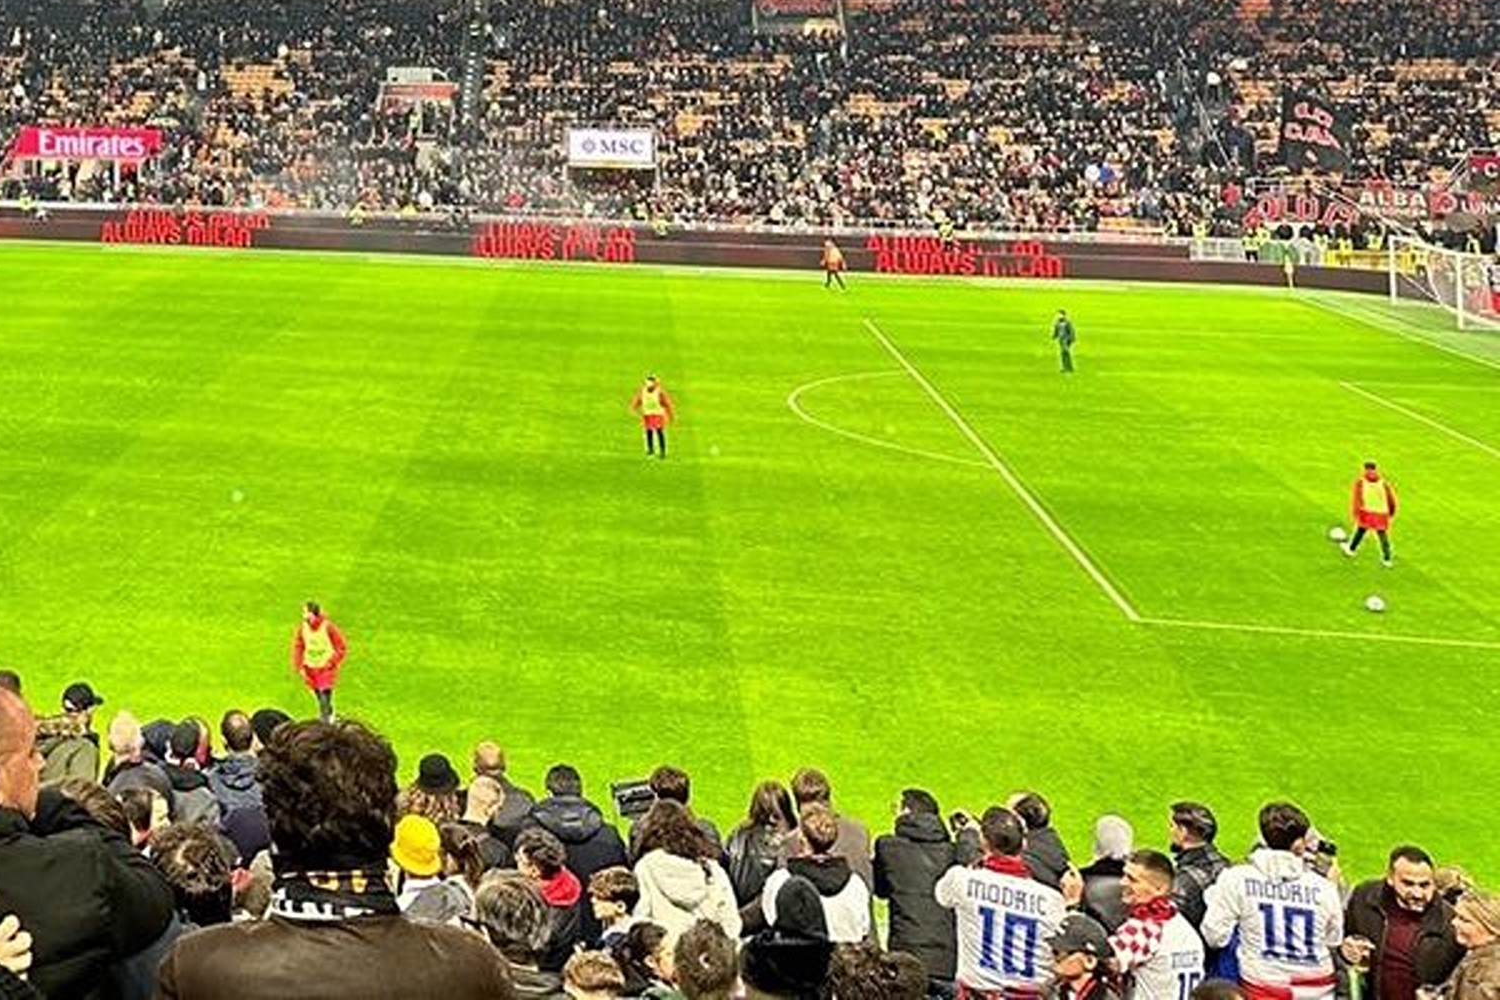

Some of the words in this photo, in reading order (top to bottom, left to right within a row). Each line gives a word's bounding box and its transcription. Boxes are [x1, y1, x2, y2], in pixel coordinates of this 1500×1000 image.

[38, 130, 145, 157] Emirates
[600, 139, 645, 154] MSC
[102, 219, 182, 244] ALWAYS
[186, 223, 252, 248] MILAN
[875, 251, 977, 276] ALWAYS
[979, 905, 1036, 978] 10
[1259, 902, 1317, 962] 10
